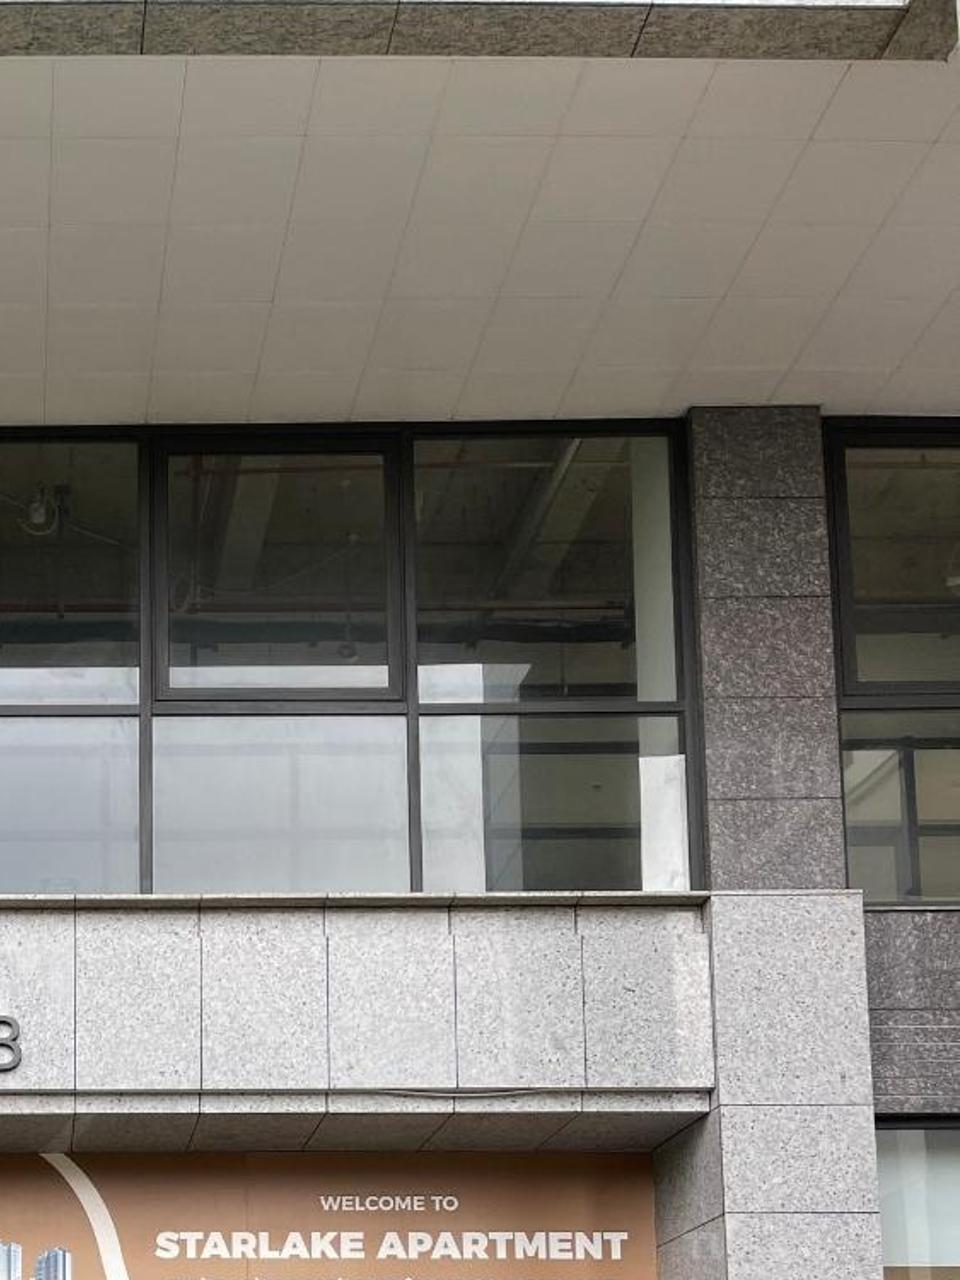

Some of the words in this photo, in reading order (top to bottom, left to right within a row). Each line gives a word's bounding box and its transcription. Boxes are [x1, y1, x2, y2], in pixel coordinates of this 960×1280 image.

[320, 1195, 426, 1211] WELCOME
[430, 1195, 459, 1211] TO
[155, 1231, 365, 1260] STARLAKE
[376, 1231, 628, 1260] APARTMENT
